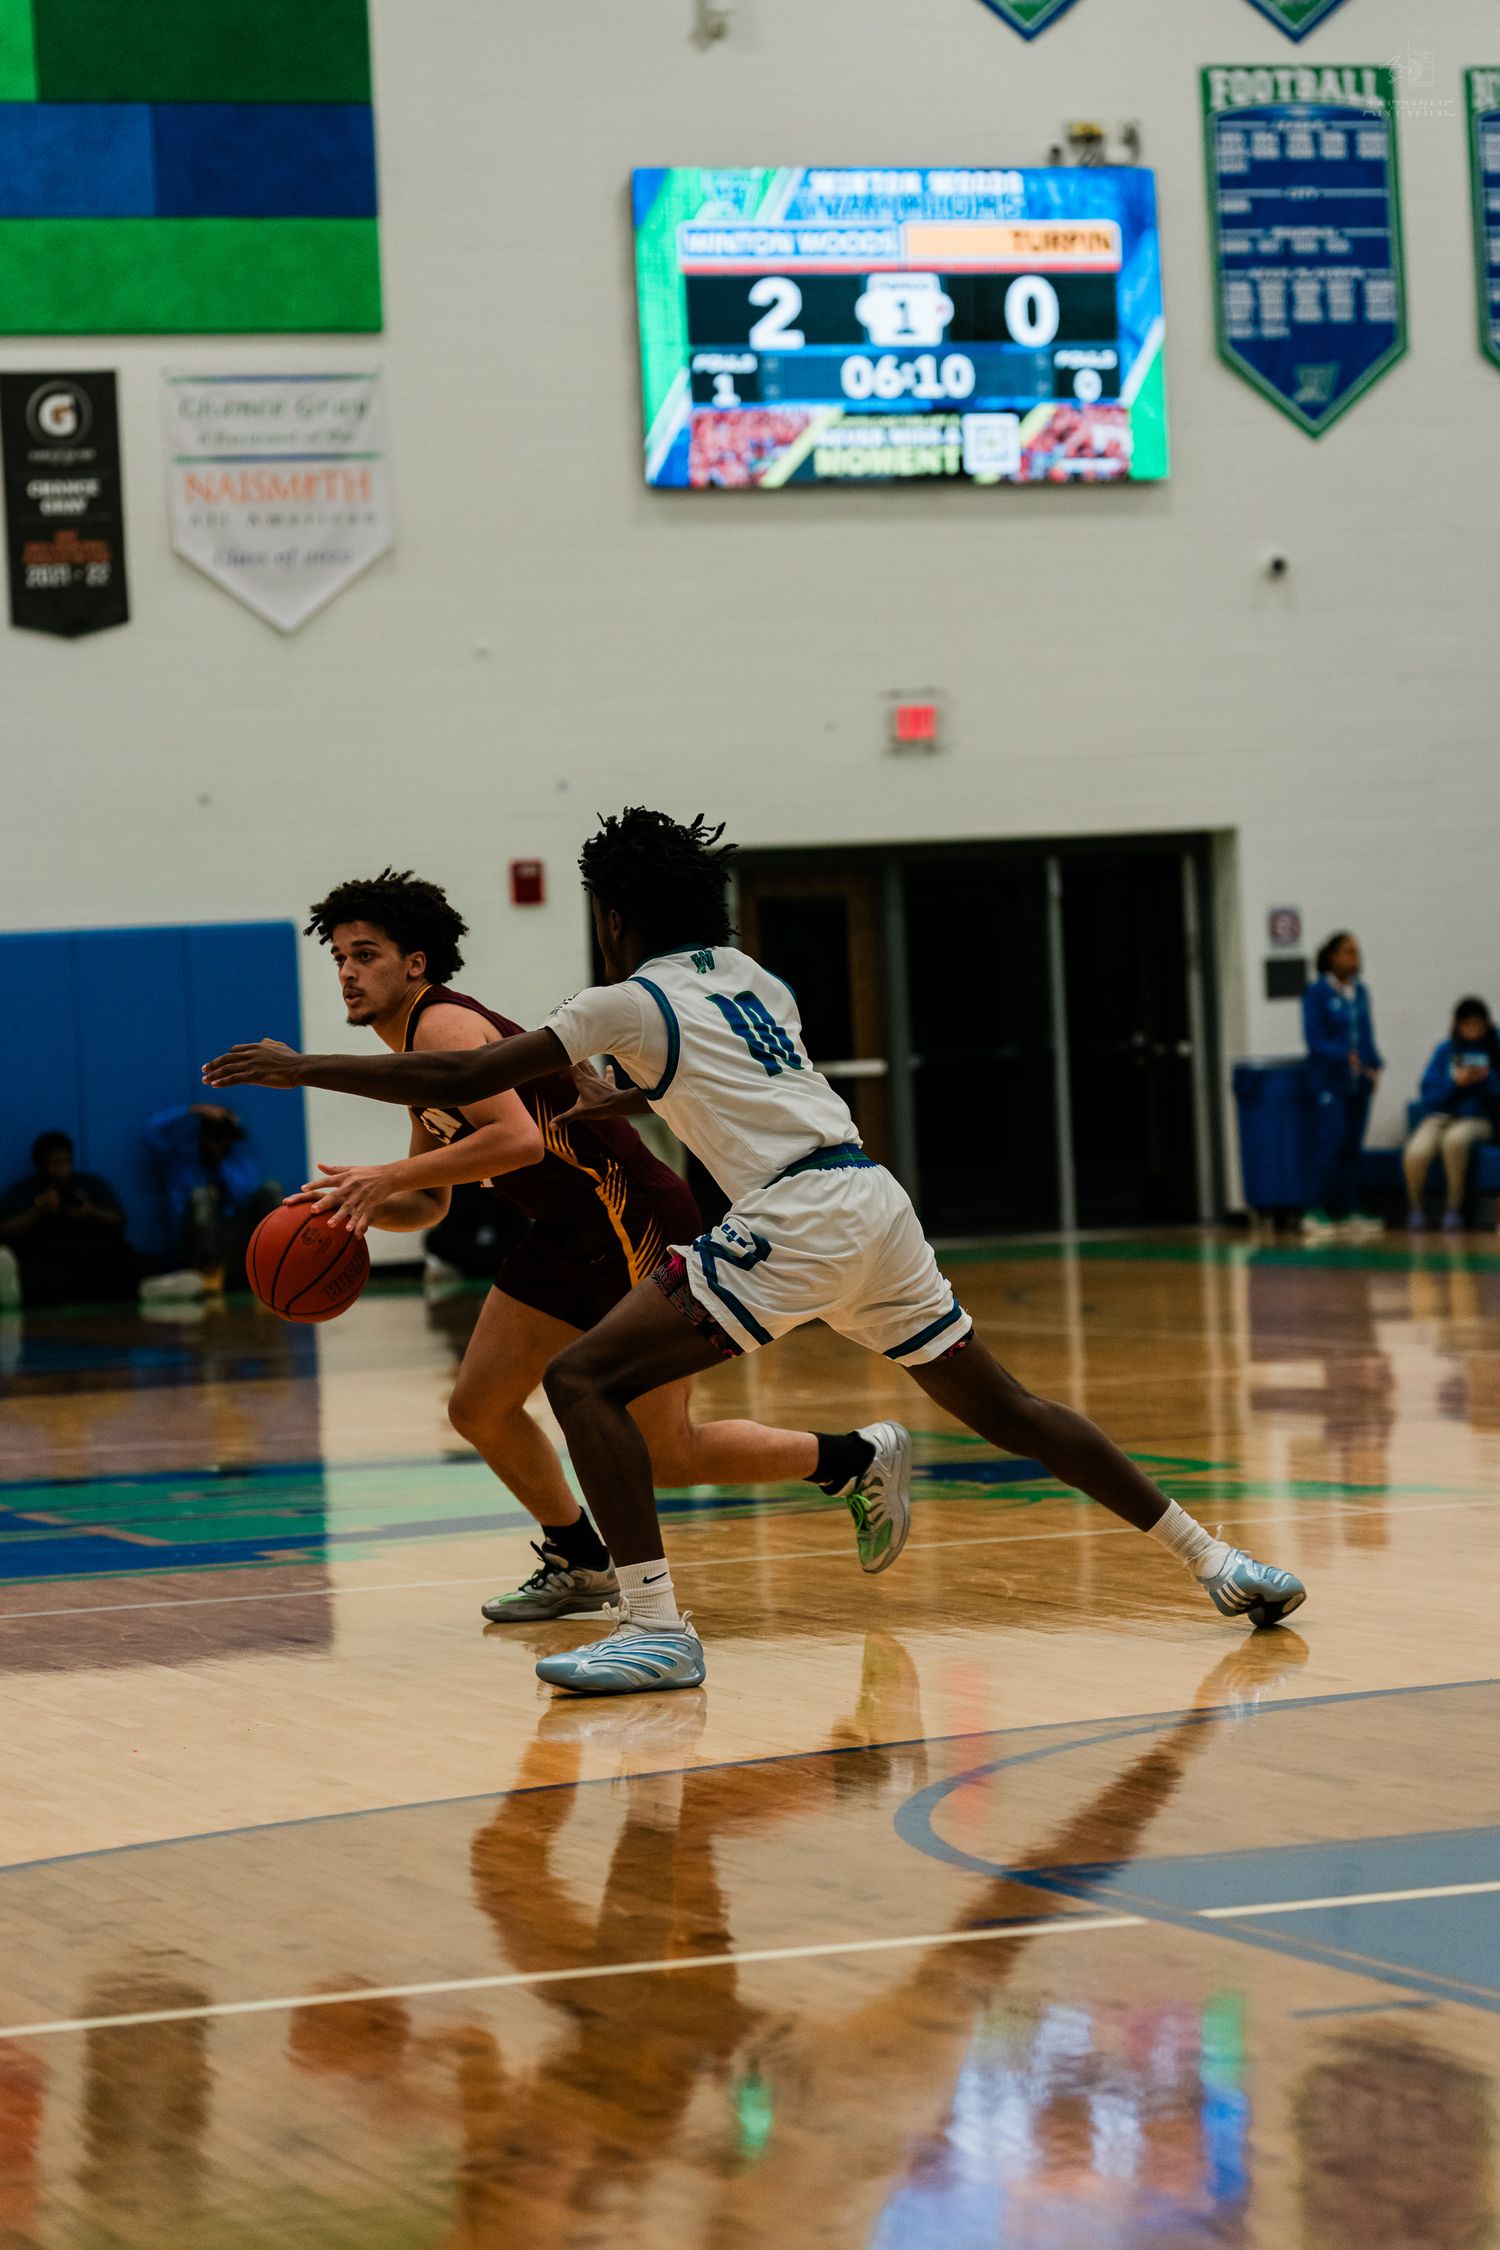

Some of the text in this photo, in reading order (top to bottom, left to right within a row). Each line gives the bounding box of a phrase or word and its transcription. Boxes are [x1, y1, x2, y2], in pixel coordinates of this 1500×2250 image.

[1208, 69, 1384, 112] FOOTBALL
[1011, 229, 1111, 254] TURPIN
[748, 276, 804, 350] 2
[895, 300, 916, 335] 1
[1004, 275, 1059, 347] 0
[711, 373, 741, 408] 1
[840, 354, 976, 399] 06:10
[1073, 368, 1102, 403] 0
[38, 393, 78, 437] G
[183, 468, 373, 505] NAISMITH
[704, 990, 805, 1078] 10
